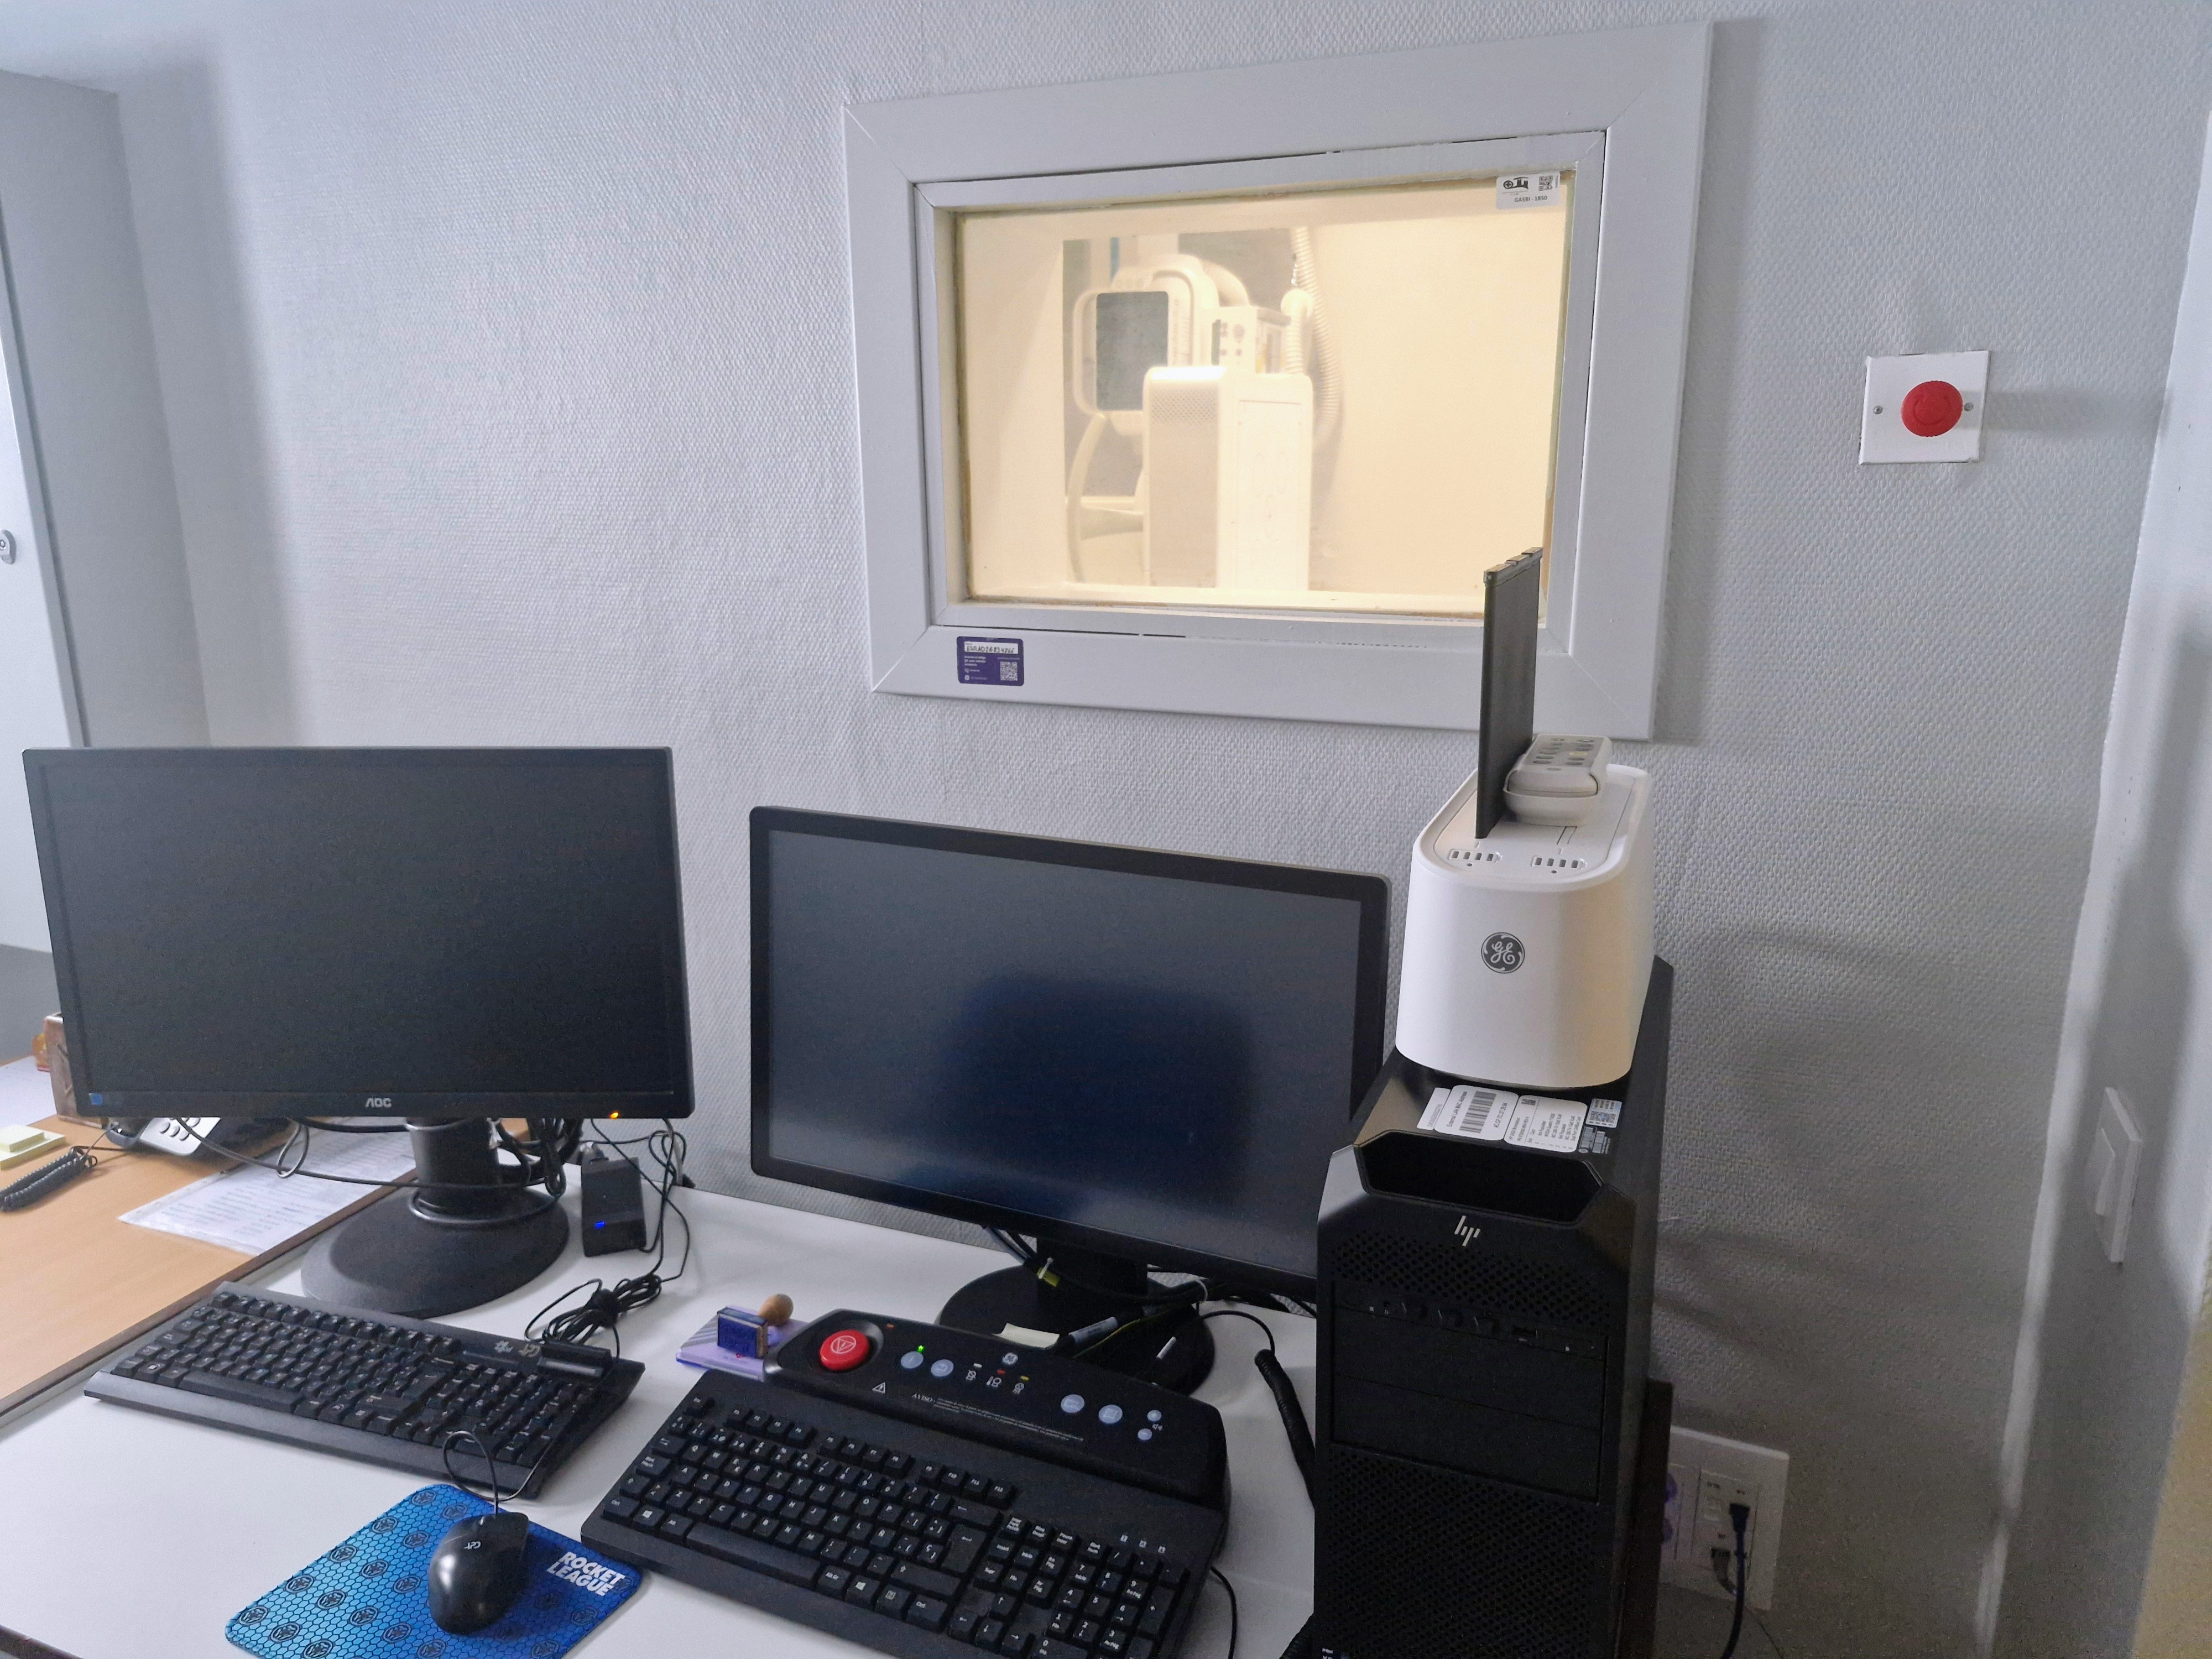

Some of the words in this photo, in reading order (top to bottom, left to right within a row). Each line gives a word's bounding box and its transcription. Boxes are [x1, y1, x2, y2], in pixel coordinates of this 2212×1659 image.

[365, 1097, 392, 1108] AOC
[1454, 1215, 1481, 1246] hp
[546, 1562, 614, 1597] LEAGUE
[558, 1551, 627, 1585] ROCKET
